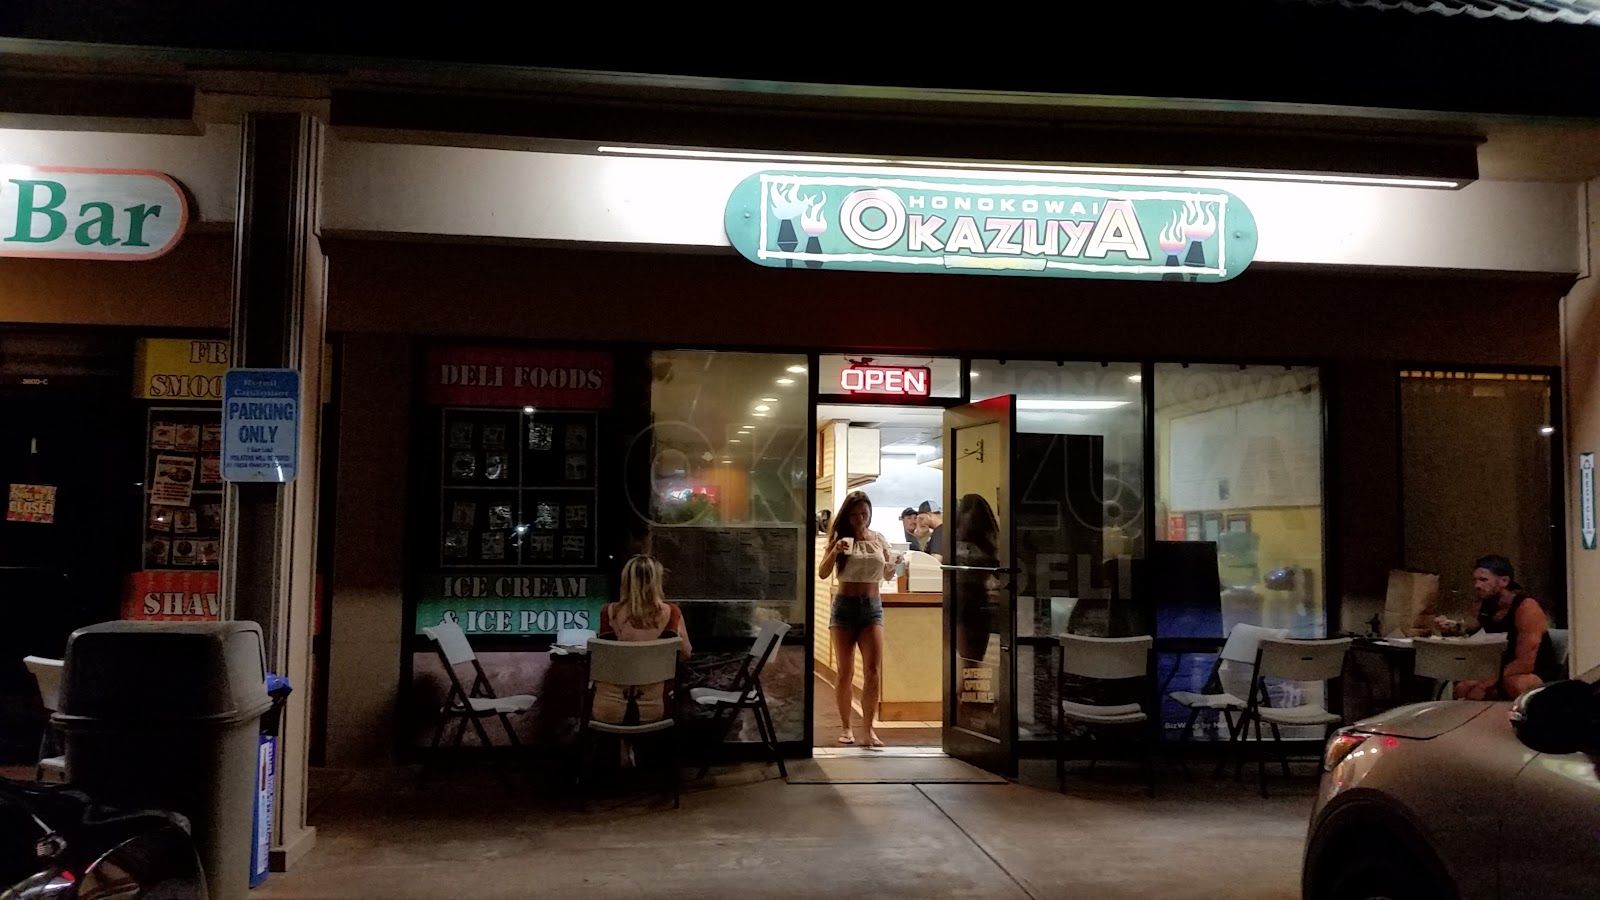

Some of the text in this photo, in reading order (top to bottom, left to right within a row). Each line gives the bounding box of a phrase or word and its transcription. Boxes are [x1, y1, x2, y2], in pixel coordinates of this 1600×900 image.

[3, 178, 162, 247] Bar
[908, 194, 1099, 215] HONOKOWAI
[838, 188, 1152, 260] OKAZUYA
[439, 363, 603, 390] DELI FOODS
[841, 369, 925, 393] OPEN
[229, 402, 293, 420] PARKING
[239, 425, 278, 443] ONLY
[443, 576, 588, 598] ICE CREAM
[466, 610, 512, 632] ICE
[518, 610, 590, 632] POPS
